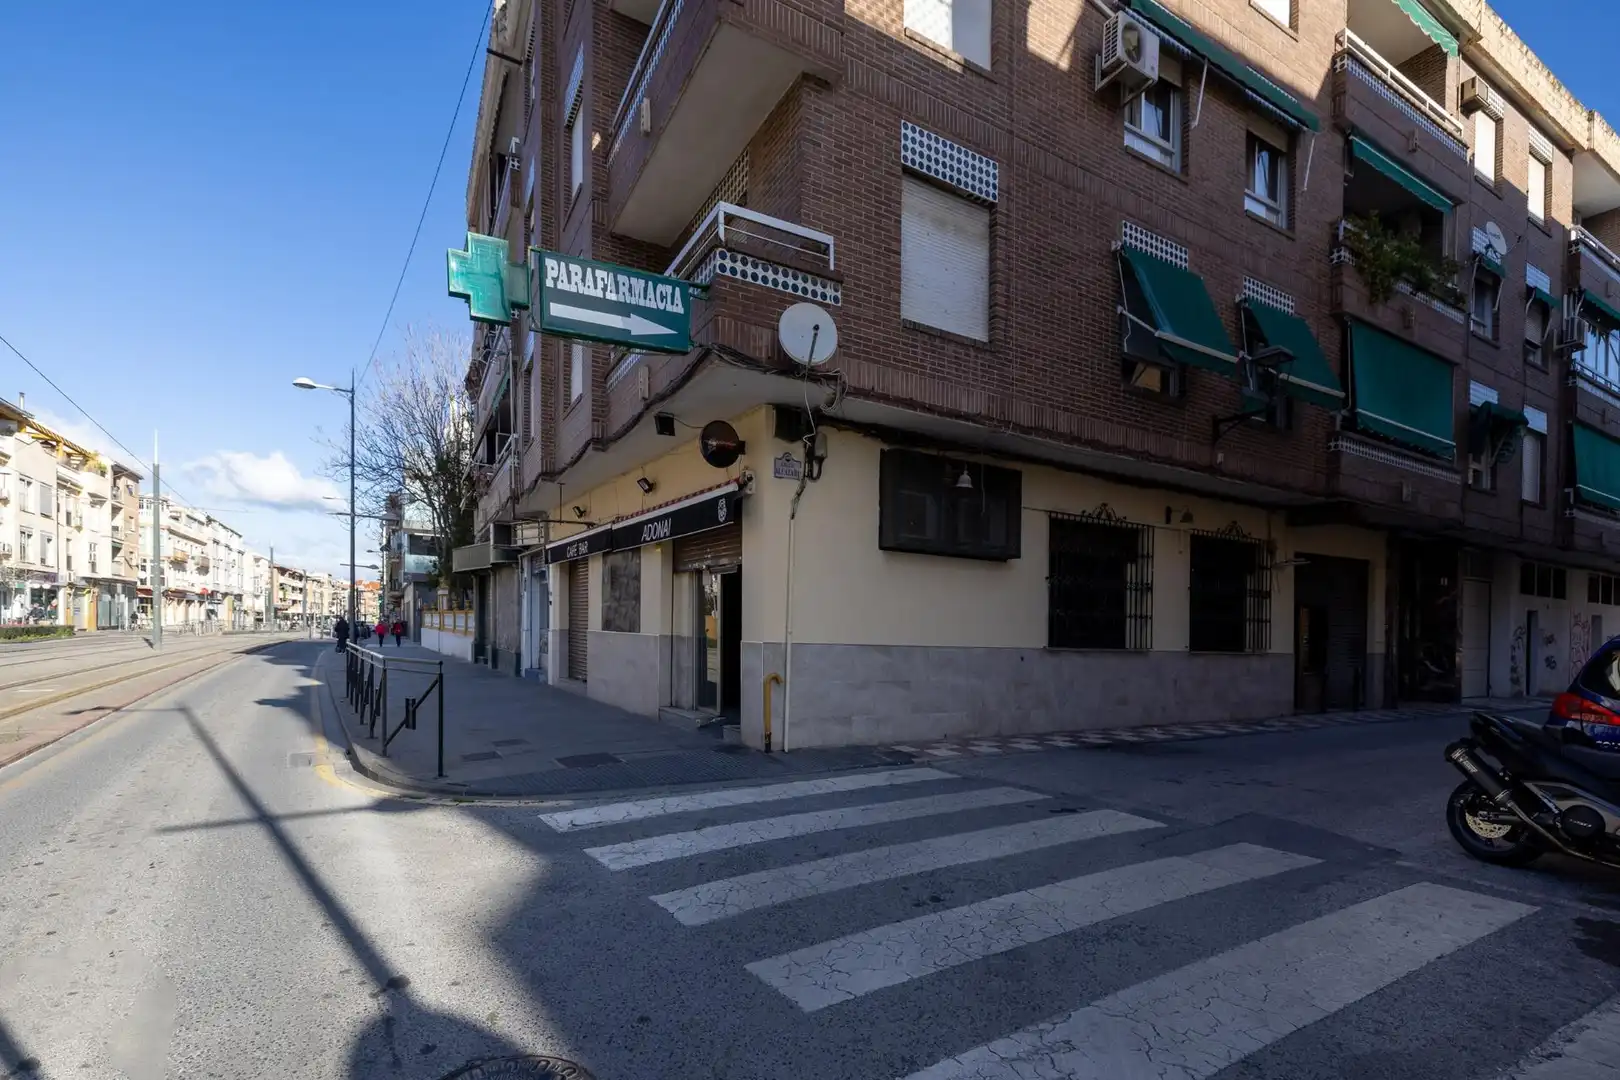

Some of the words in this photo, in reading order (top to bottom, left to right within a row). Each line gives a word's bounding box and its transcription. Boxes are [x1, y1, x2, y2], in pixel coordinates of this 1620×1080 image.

[545, 257, 684, 314] PARAFARMACIA
[641, 517, 672, 542] ADONAI
[578, 541, 588, 555] BAR
